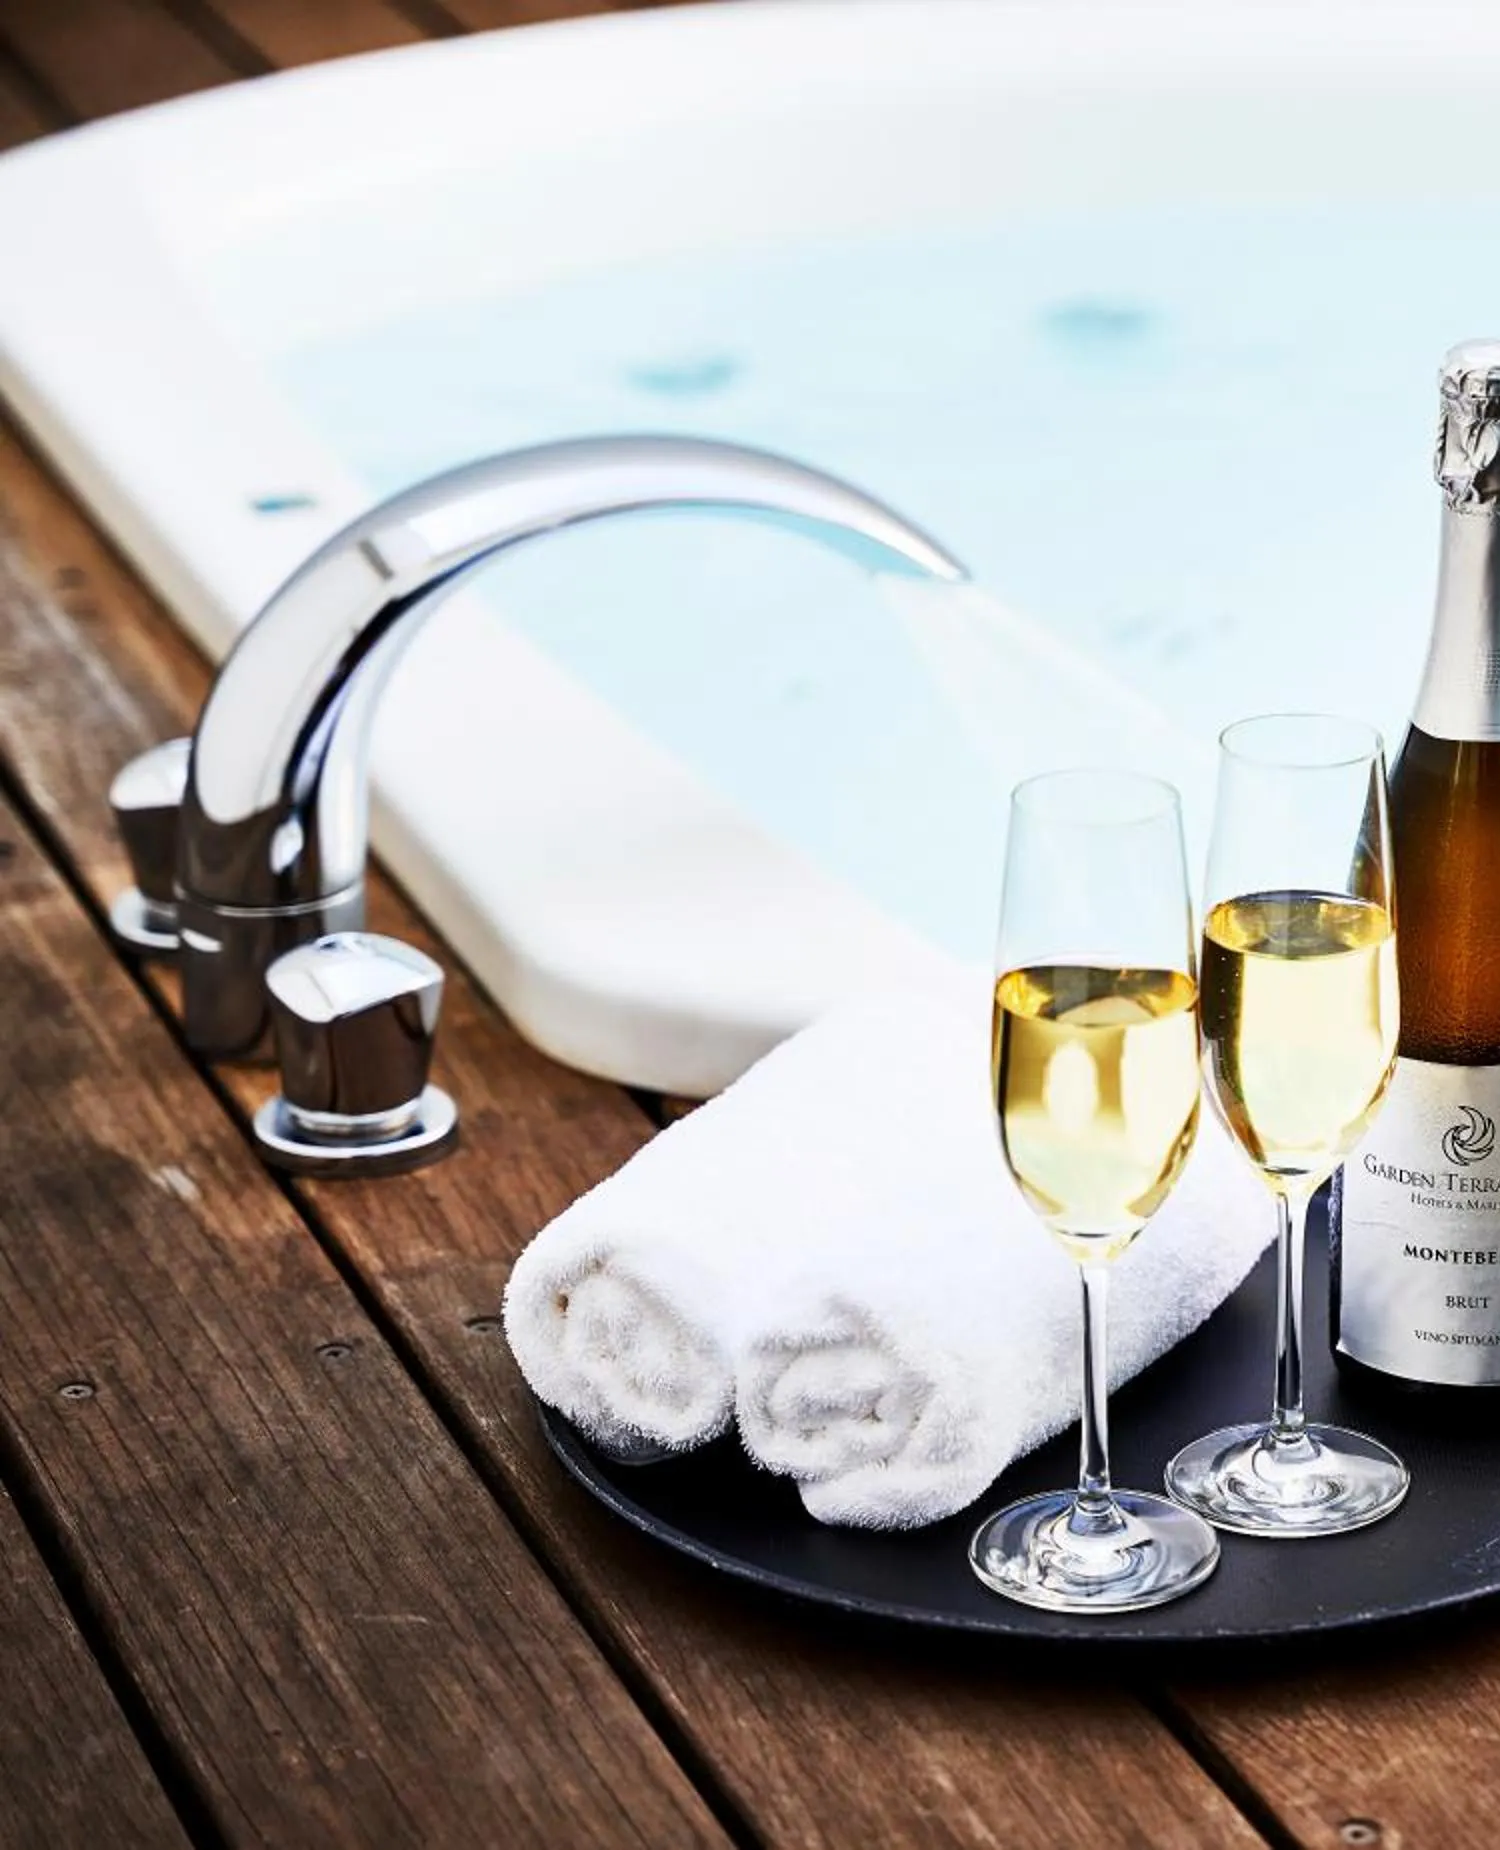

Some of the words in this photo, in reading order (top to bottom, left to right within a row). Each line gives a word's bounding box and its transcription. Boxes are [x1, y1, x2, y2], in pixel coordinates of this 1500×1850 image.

[1363, 1153, 1436, 1188] GARDEN
[1444, 1295, 1492, 1309] BRUT
[1413, 1330, 1449, 1344] VINO
